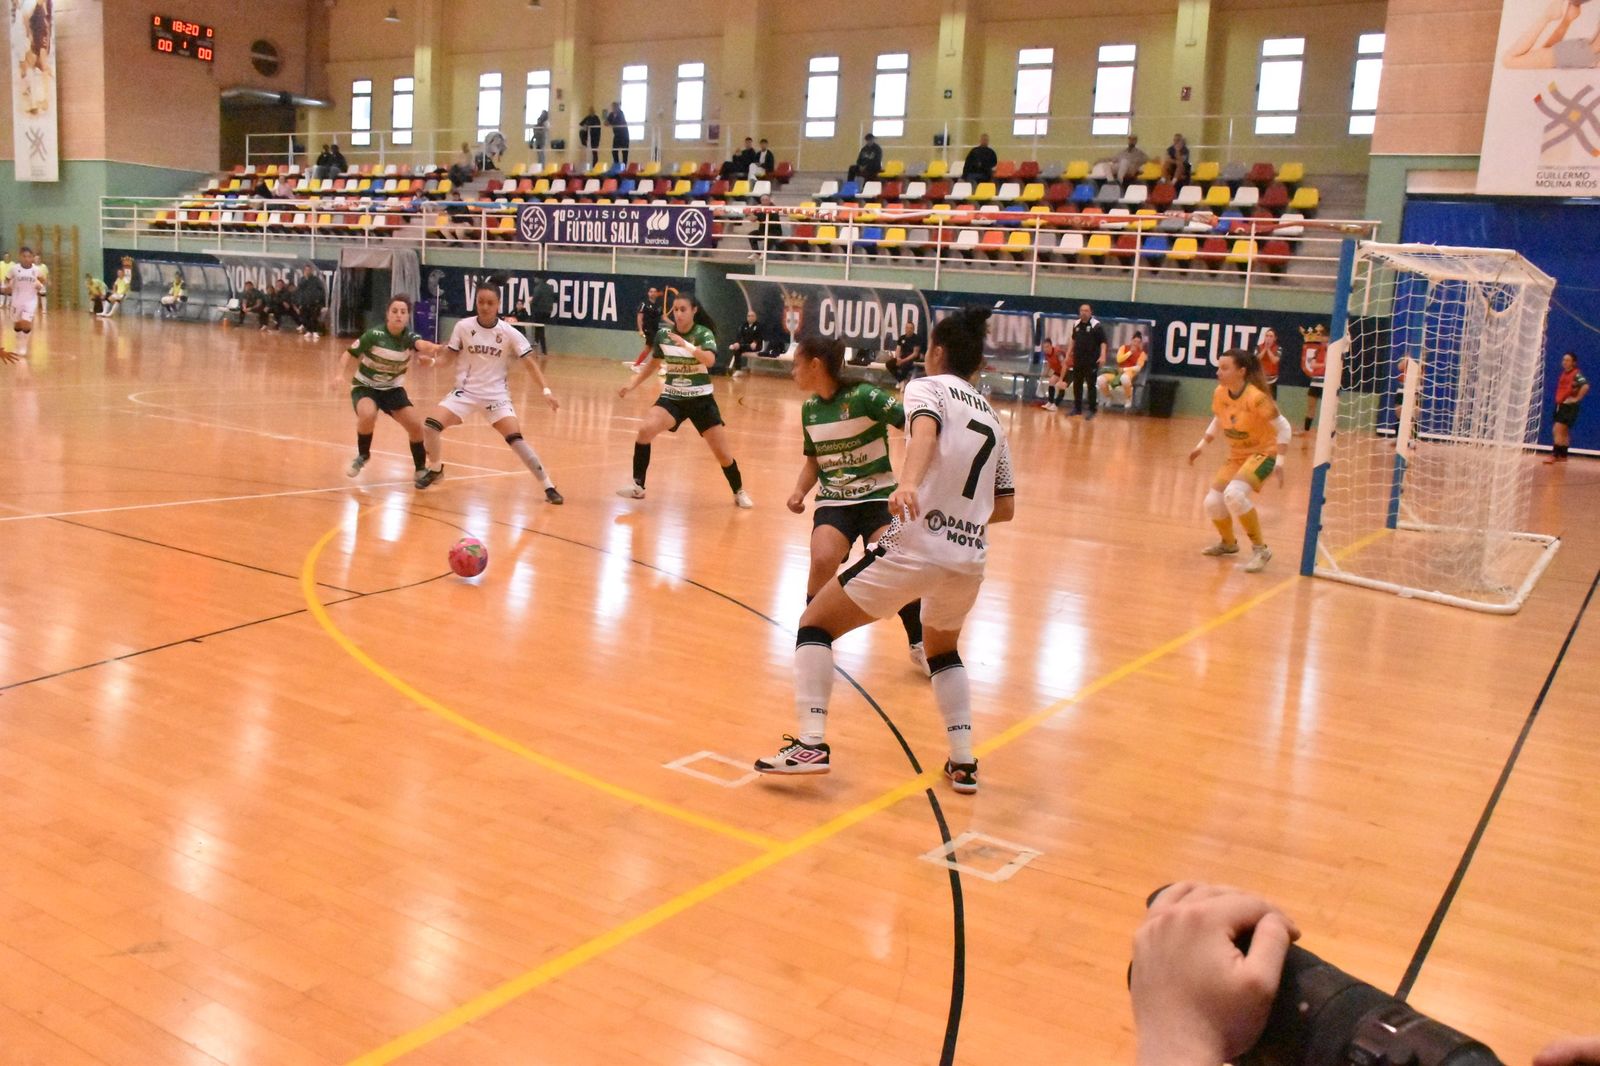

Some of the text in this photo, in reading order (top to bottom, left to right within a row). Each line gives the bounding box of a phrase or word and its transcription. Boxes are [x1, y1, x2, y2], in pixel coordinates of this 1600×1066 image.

[172, 21, 199, 36] 18:20
[158, 39, 173, 52] 00
[198, 47, 212, 60] 00
[1535, 180, 1572, 188] MOLINA
[1536, 171, 1591, 180] GUILLERMO
[567, 208, 640, 220] DIVISIÓN
[566, 217, 639, 243] FÚTBOL SALA
[464, 274, 532, 316] VITA
[818, 298, 919, 342] CIUDAD
[468, 345, 502, 358] CEUTA
[961, 418, 997, 500] 7
[947, 515, 985, 537] DARYS
